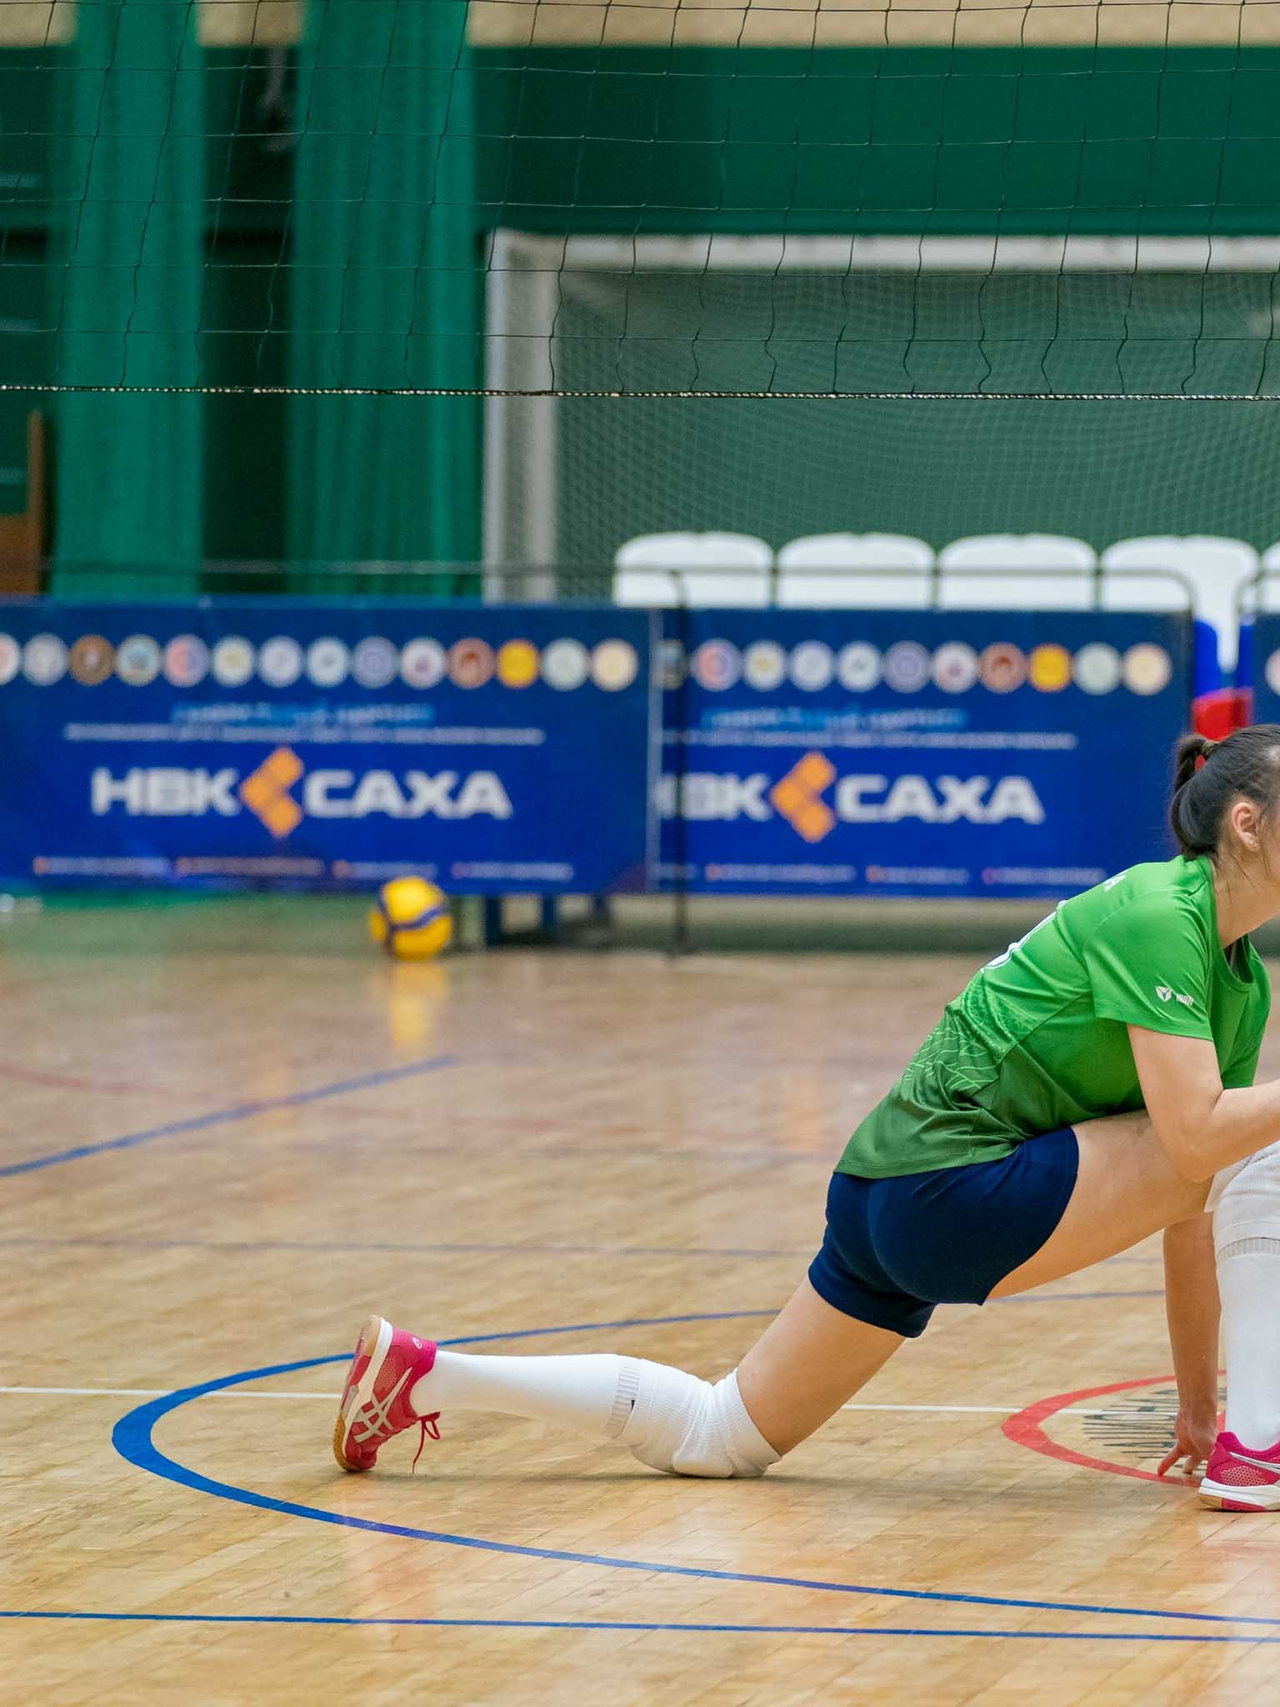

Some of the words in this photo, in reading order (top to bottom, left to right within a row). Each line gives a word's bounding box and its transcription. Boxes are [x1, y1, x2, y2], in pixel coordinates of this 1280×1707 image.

[90, 766, 242, 817] НВК
[302, 768, 514, 820] САХА
[835, 773, 1046, 824] САХА
